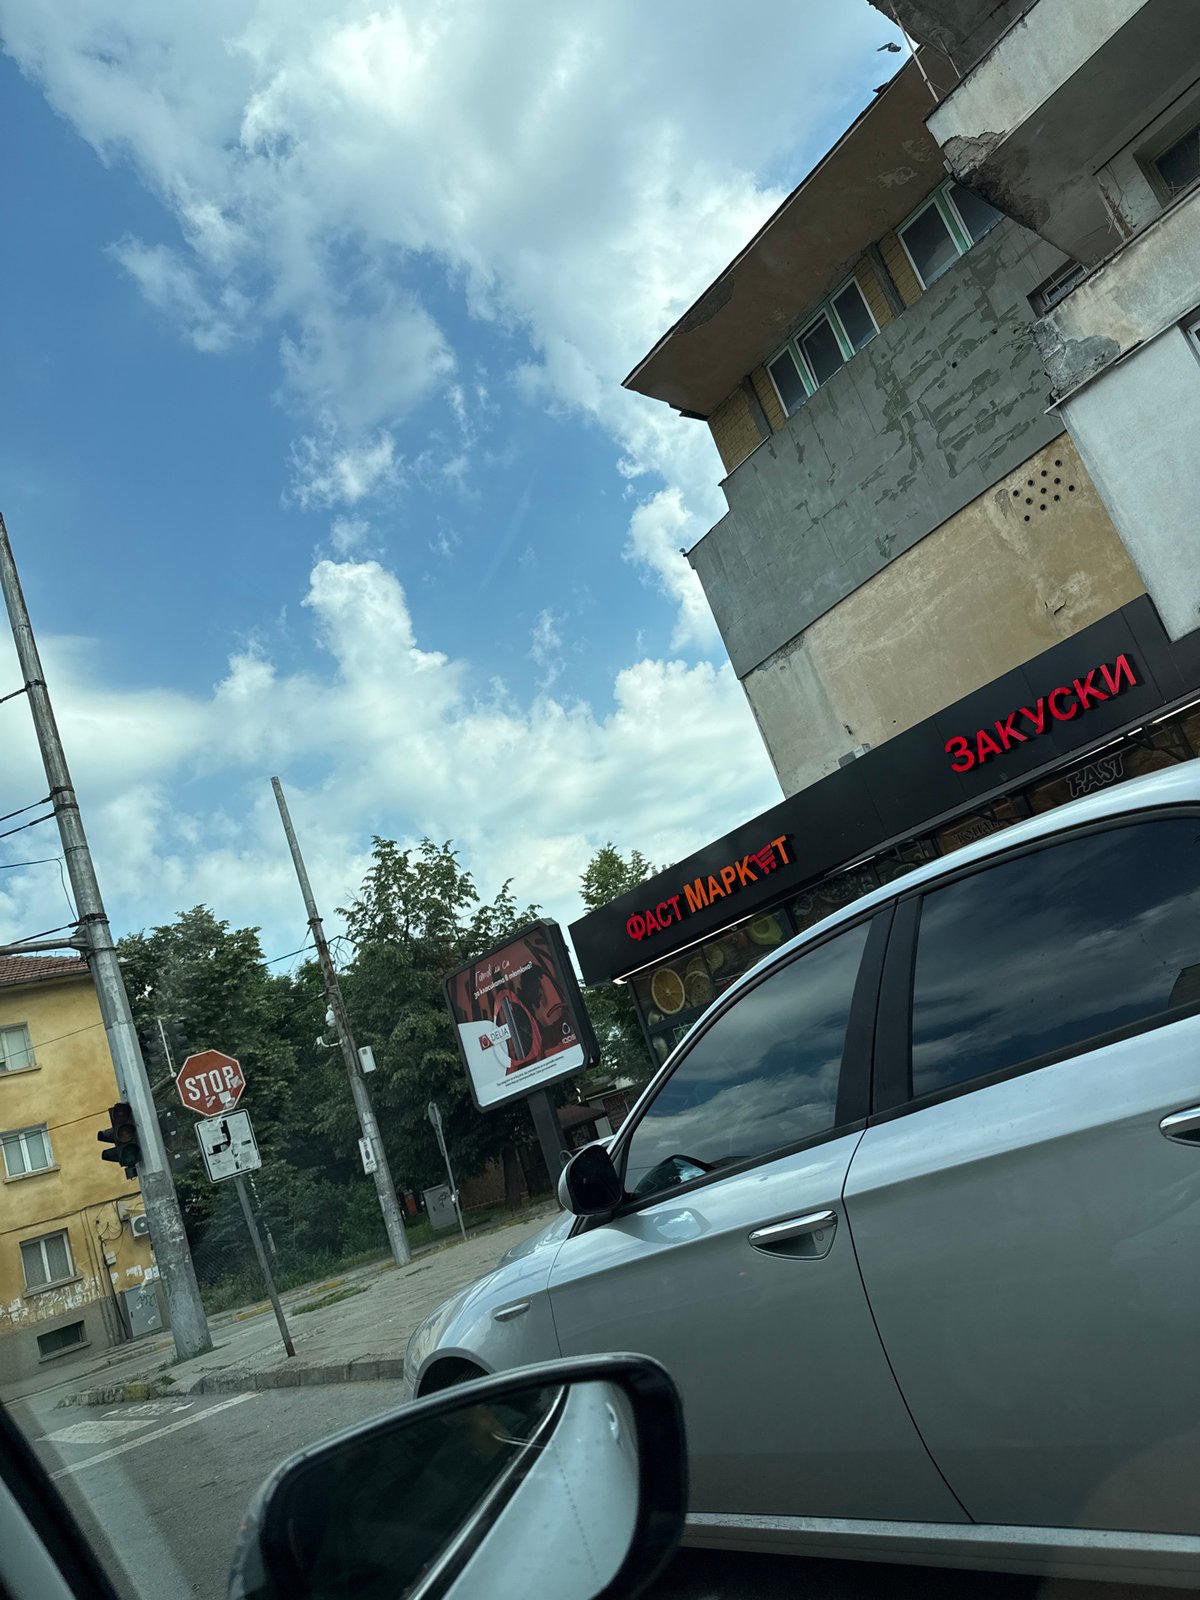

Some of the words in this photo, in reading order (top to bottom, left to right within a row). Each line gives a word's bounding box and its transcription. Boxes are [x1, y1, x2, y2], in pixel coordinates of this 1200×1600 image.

[944, 653, 1137, 773] ЗАКУСКИ
[1066, 752, 1124, 799] FAST
[626, 895, 682, 941] ФАСТ
[490, 1028, 509, 1042] DELIA
[184, 1066, 234, 1101] STOP
